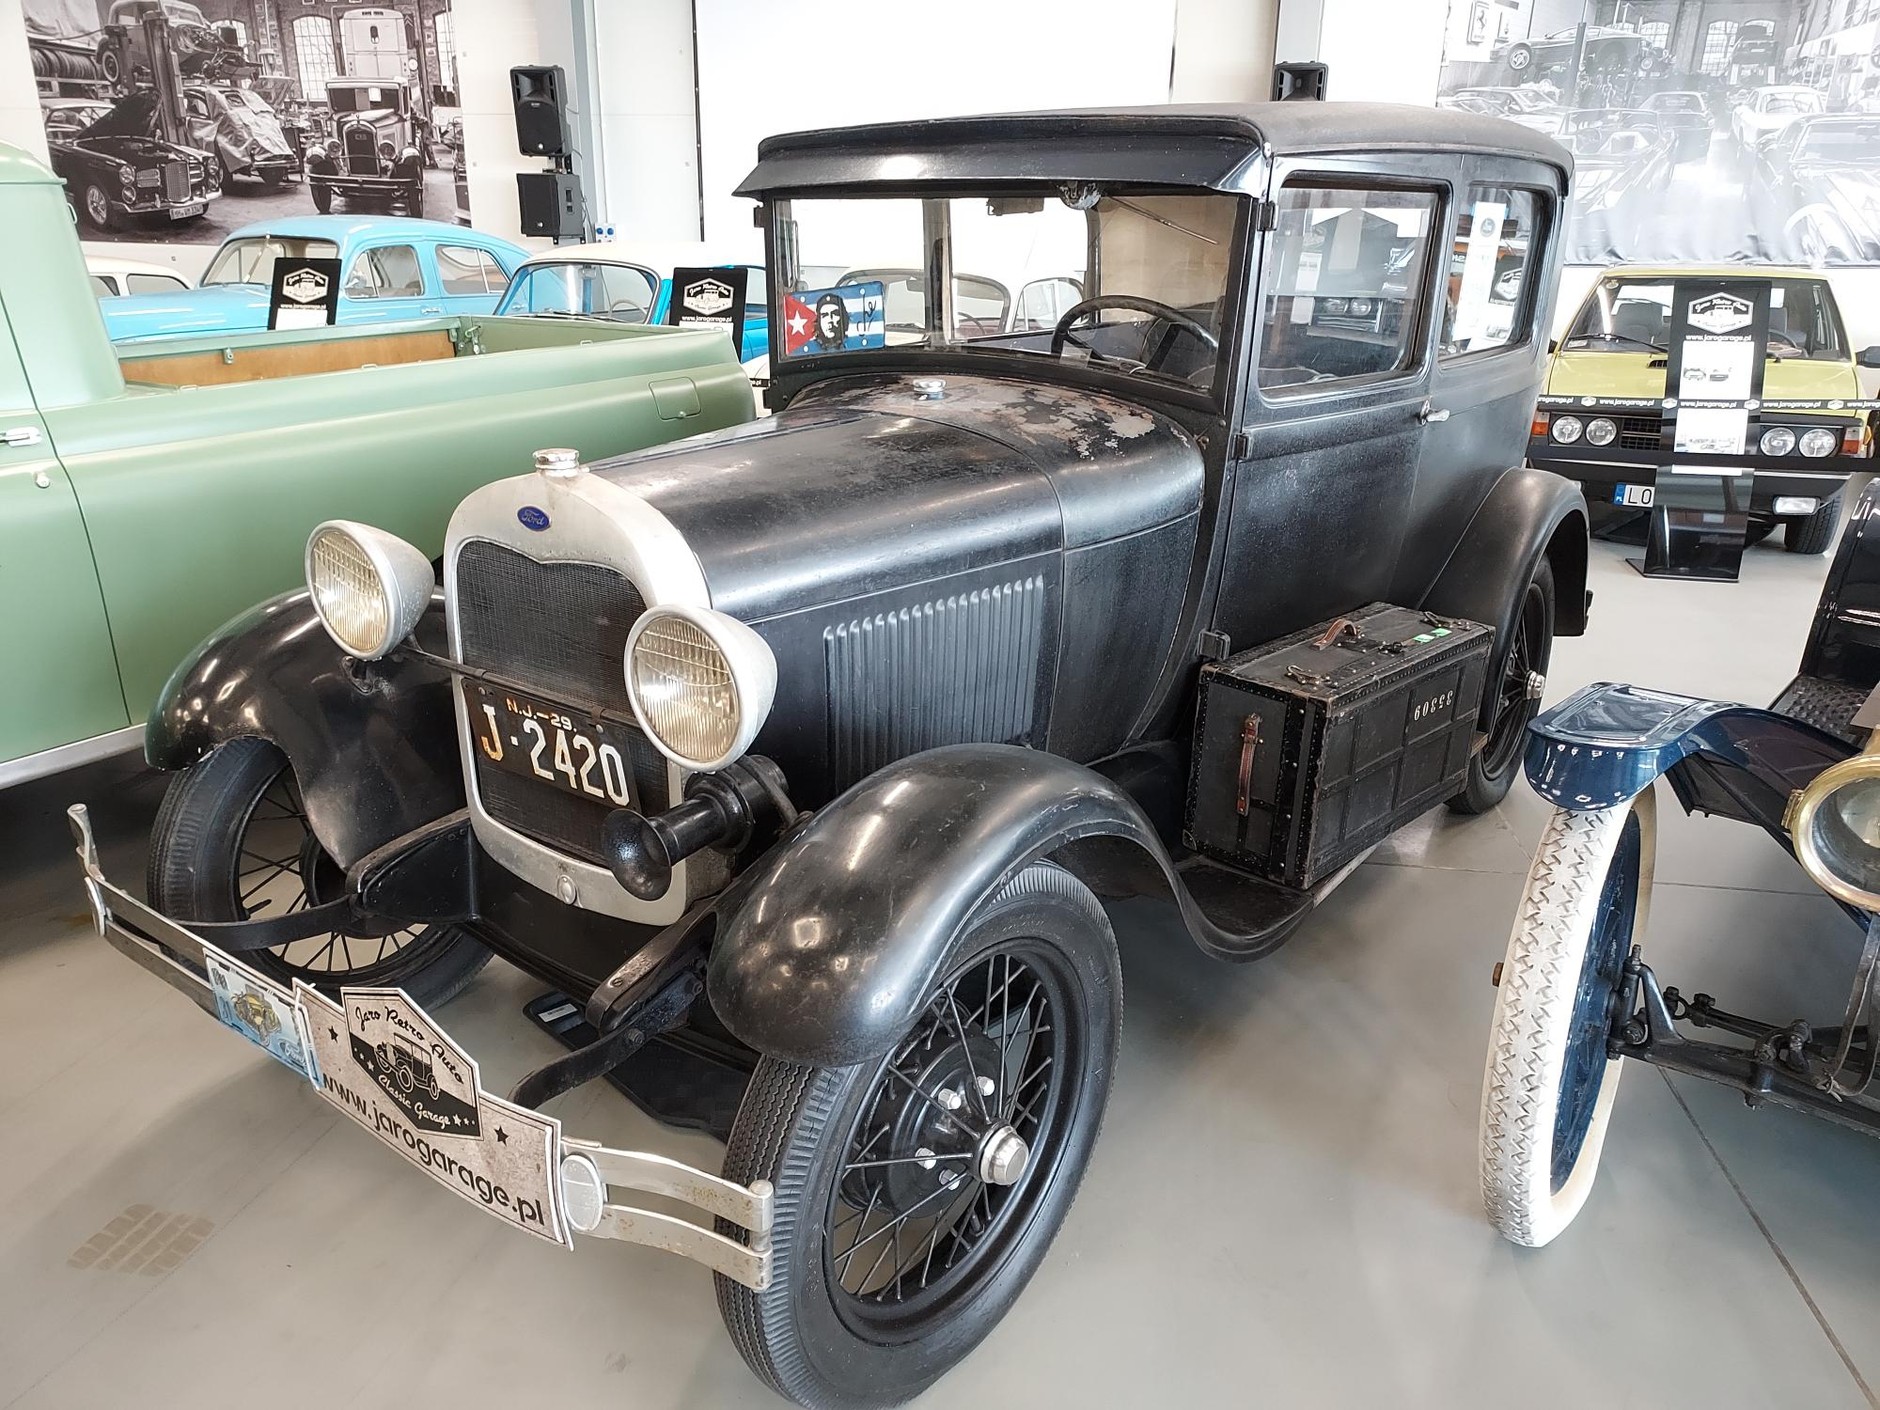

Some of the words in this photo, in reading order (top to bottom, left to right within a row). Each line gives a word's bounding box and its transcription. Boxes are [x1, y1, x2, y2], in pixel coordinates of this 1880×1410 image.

[521, 509, 545, 526] Ford
[355, 1006, 381, 1032] Jaro
[384, 1006, 425, 1041] Retro
[429, 1041, 464, 1085] Auto
[378, 1074, 412, 1109] Classic
[414, 1101, 451, 1130] Garage
[323, 1072, 545, 1227] www.jarogarage.pl
